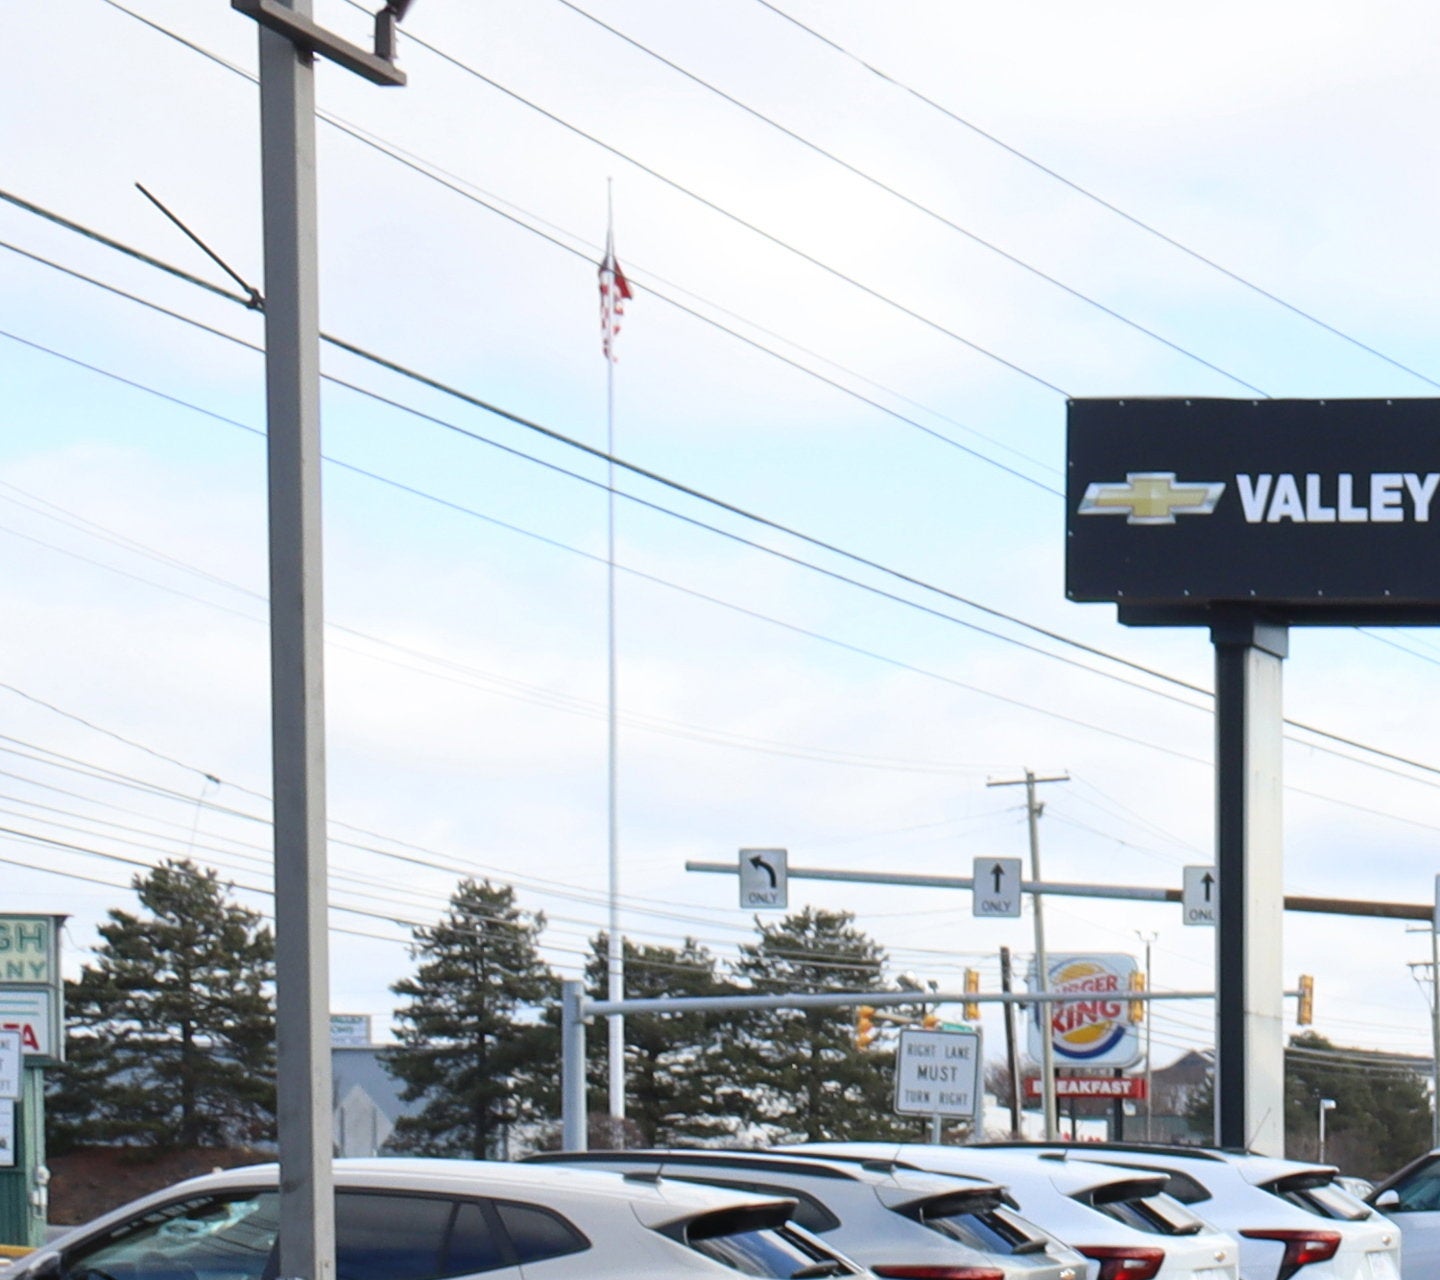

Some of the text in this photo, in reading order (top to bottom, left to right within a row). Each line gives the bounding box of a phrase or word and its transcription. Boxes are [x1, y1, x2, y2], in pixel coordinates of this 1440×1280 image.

[1236, 472, 1440, 523] VALLEY
[748, 892, 778, 904] ONLY
[982, 901, 1011, 912] ONLY
[1189, 908, 1215, 920] ONL
[907, 1043, 971, 1060] RIGHT LANE
[917, 1064, 959, 1082] MUST
[1033, 1080, 1132, 1095] BEAKFAST
[905, 1089, 969, 1106] TURN RIGHT
